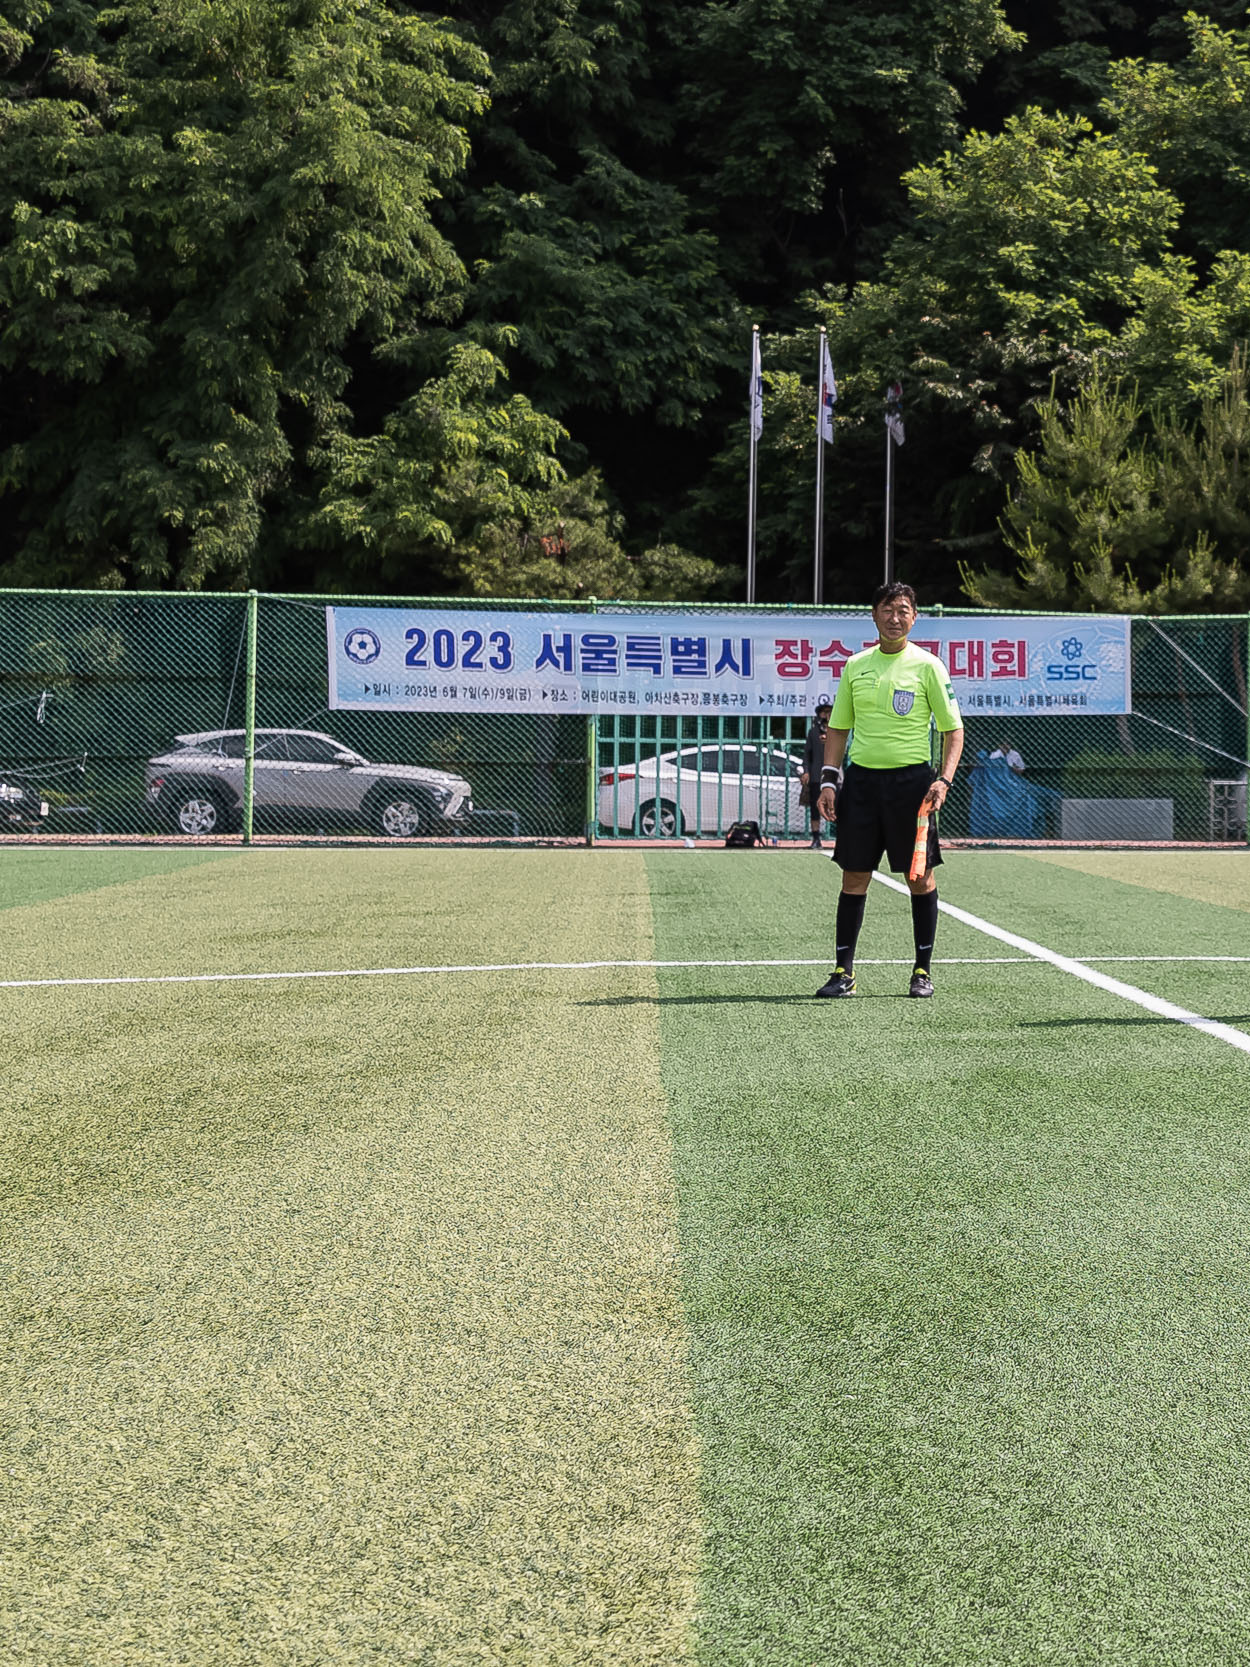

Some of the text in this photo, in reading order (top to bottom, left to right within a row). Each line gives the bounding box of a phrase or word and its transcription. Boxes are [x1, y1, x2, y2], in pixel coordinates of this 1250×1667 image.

[404, 627, 1027, 679] 2023 서울특별시 장수대회
[1046, 664, 1098, 681] SSC
[373, 683, 391, 696] 일시
[404, 684, 438, 698] 2023년
[442, 685, 458, 699] 6월
[462, 686, 532, 701] 7일(수)/9일(금)
[551, 688, 569, 702] 장소
[581, 689, 640, 704] 어린이대공원,
